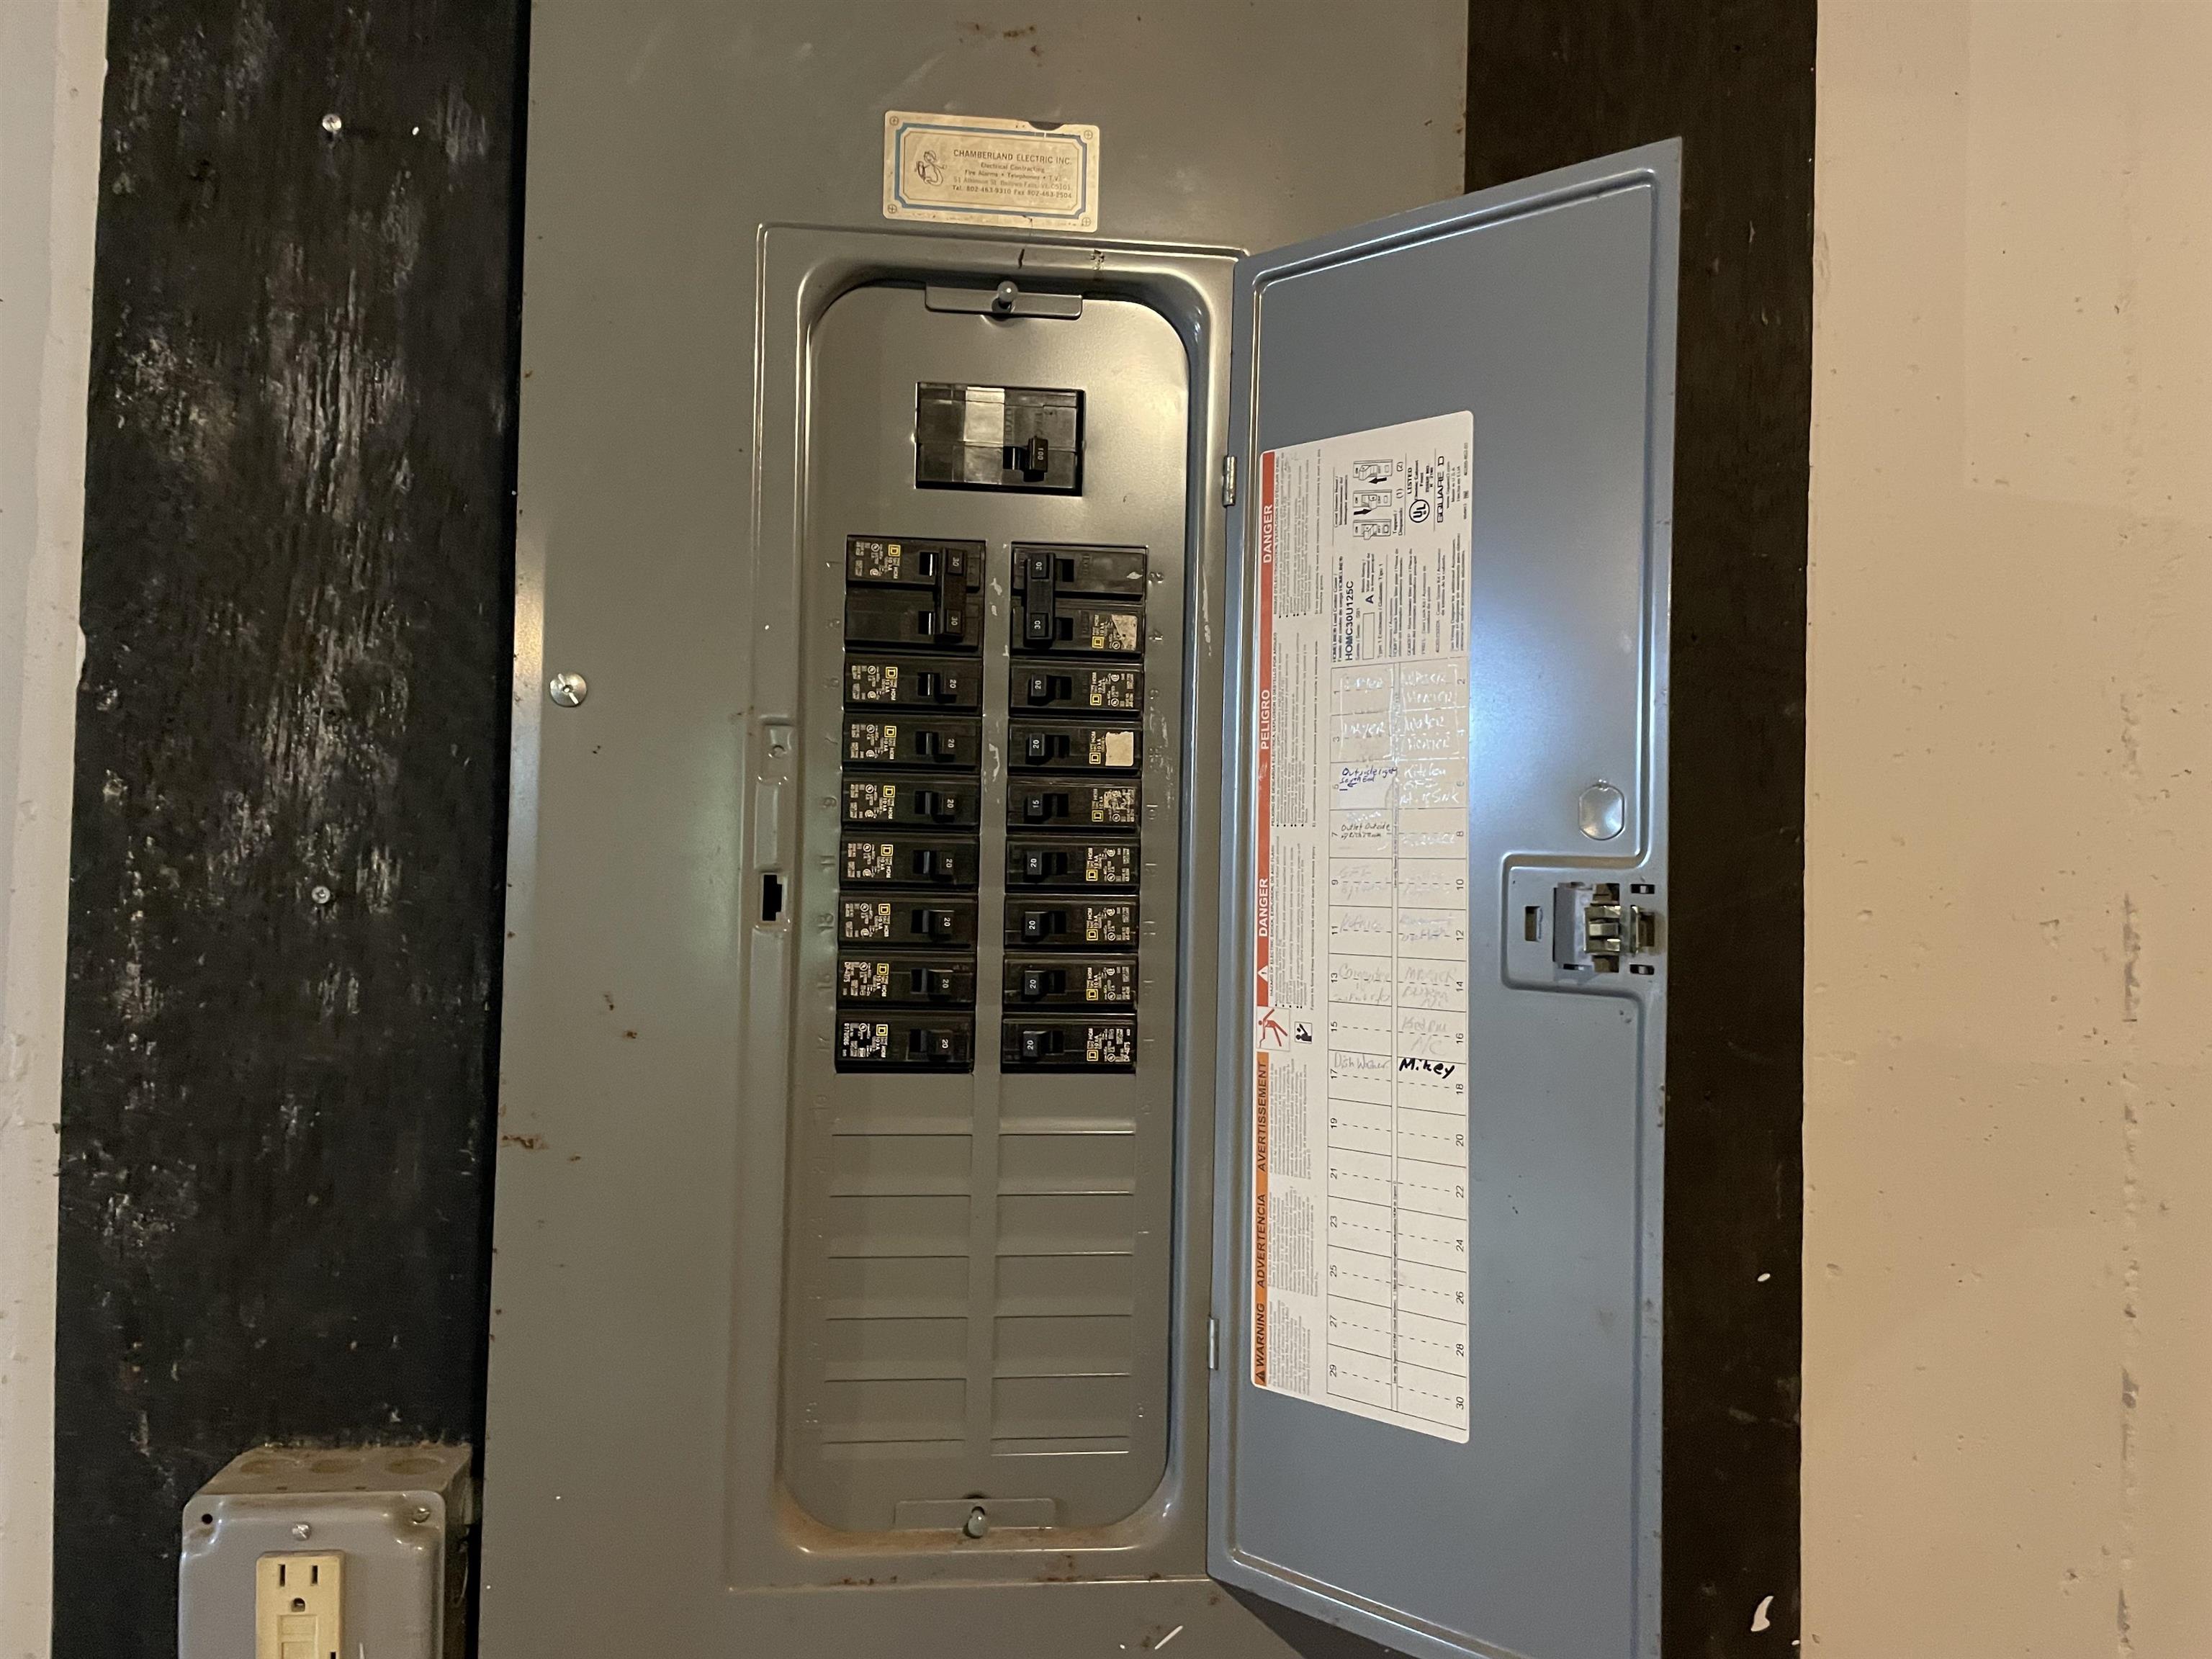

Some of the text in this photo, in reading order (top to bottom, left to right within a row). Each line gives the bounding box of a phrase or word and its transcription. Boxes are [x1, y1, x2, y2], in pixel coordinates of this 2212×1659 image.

[953, 149, 1071, 166] CHAMBERLAND ELECTRIC INC.
[1010, 164, 1045, 174] Contracting
[1438, 457, 1444, 466] D
[1264, 504, 1272, 562] DANGER
[953, 557, 959, 567] 30
[1036, 562, 1042, 570] 30
[1365, 595, 1373, 604] A
[951, 616, 958, 626] 30
[1035, 620, 1040, 629] 30
[950, 679, 956, 688] 20
[1035, 680, 1041, 689] 20
[1261, 690, 1269, 750] PELIGRO
[948, 739, 954, 747] 20
[1033, 739, 1039, 749] 20
[948, 799, 954, 808] 20
[946, 858, 952, 868] 20
[1030, 858, 1037, 867] 20
[1457, 878, 1464, 890] 10
[1259, 878, 1267, 936] DANGER
[944, 917, 950, 926] 20
[1029, 920, 1035, 930] 20
[1331, 925, 1338, 935] 11
[1457, 930, 1464, 940] 12
[1331, 973, 1338, 983] 13
[943, 979, 949, 988] 20
[1030, 979, 1036, 989] 20
[1456, 981, 1463, 992] 14
[1331, 1021, 1337, 1032] 15
[1456, 1033, 1463, 1043] 16
[942, 1039, 948, 1048] 20
[1028, 1040, 1033, 1050] 20
[1331, 1069, 1337, 1079] 17
[1456, 1084, 1463, 1094] 18
[1257, 1061, 1266, 1172] AVERTISSEMENT
[1330, 1118, 1337, 1129] 19
[1456, 1134, 1465, 1146] 20
[1330, 1167, 1337, 1179] 21
[1456, 1186, 1465, 1198] 22
[1330, 1215, 1337, 1228] 23
[1257, 1194, 1266, 1288] ADVERTENCIA
[1456, 1239, 1465, 1252] 24
[1330, 1265, 1337, 1277] 25
[1456, 1292, 1465, 1304] 26
[1330, 1316, 1337, 1327] 27
[1256, 1303, 1265, 1367] WARNING
[1456, 1344, 1465, 1357] 28
[1330, 1364, 1337, 1377] 29
[1456, 1397, 1465, 1410] 30
